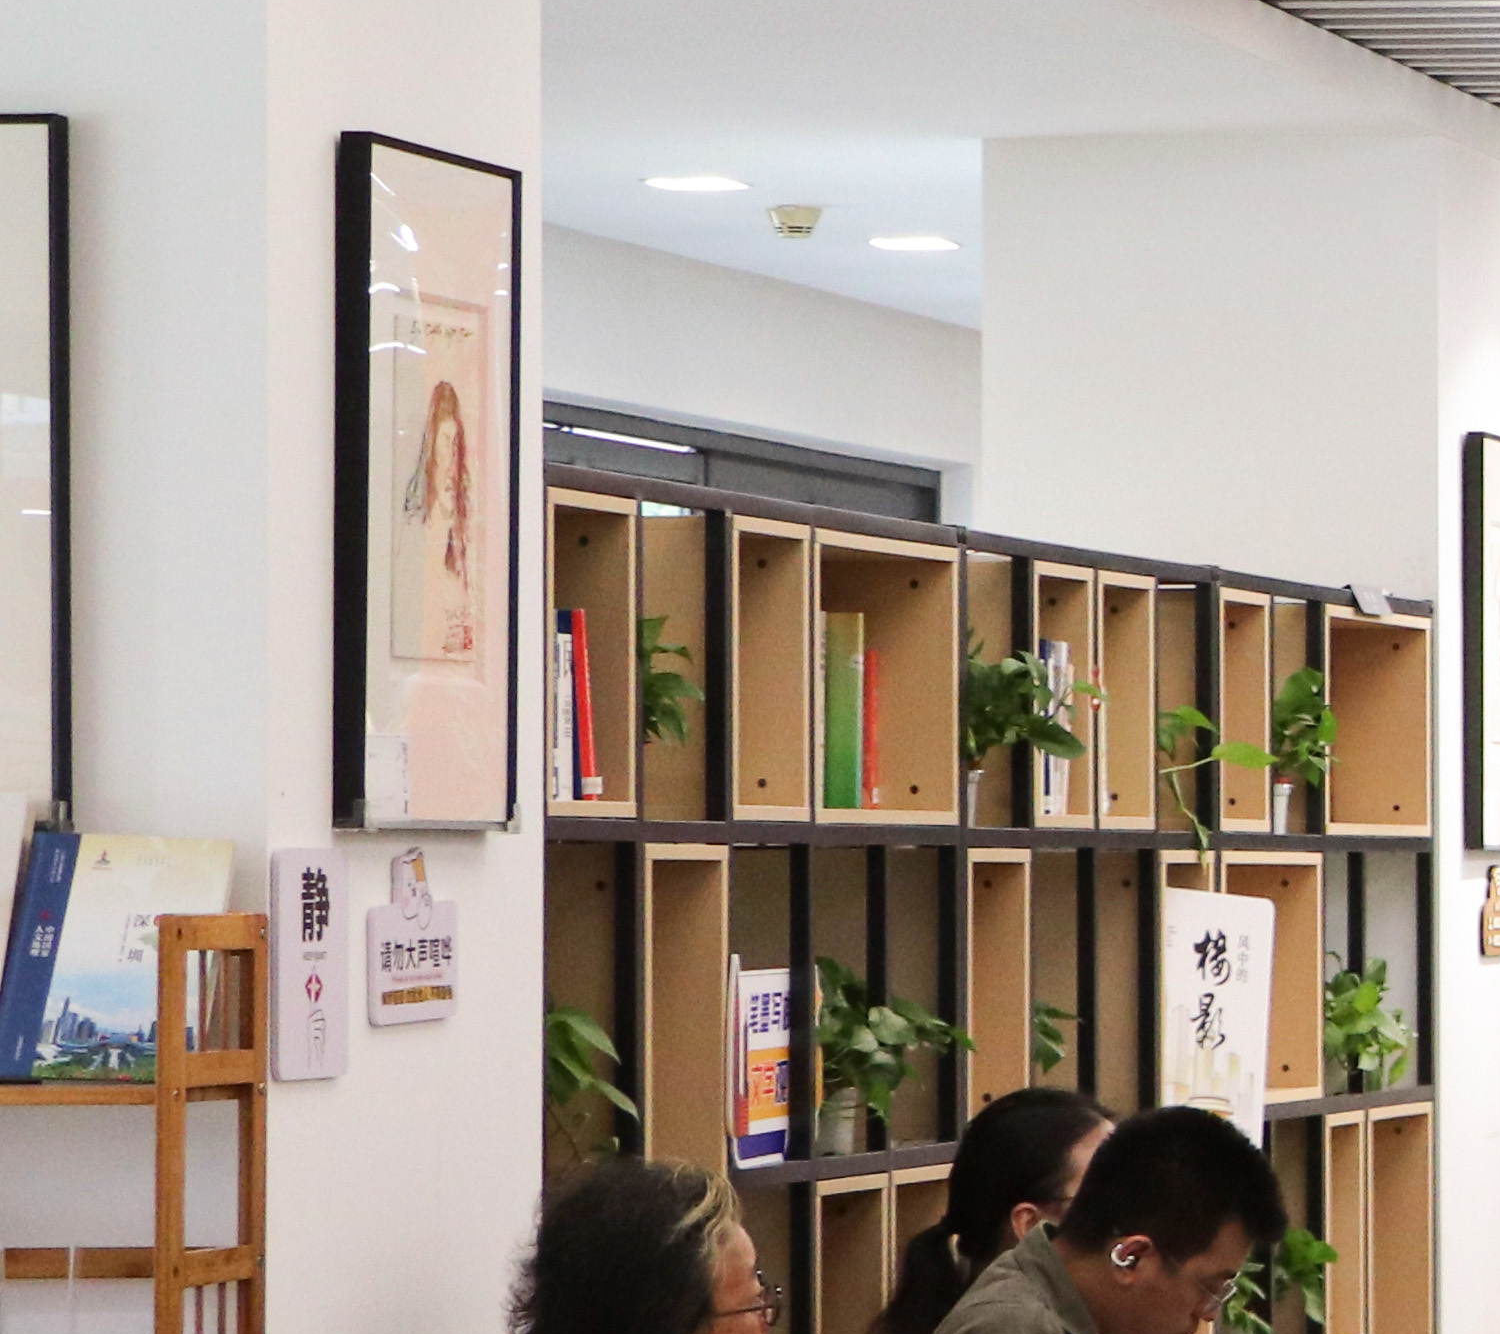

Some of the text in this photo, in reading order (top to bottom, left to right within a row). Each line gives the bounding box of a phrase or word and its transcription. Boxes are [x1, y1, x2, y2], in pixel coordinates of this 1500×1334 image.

[301, 867, 330, 942] 静
[380, 936, 452, 972] 请勿大声喧哗
